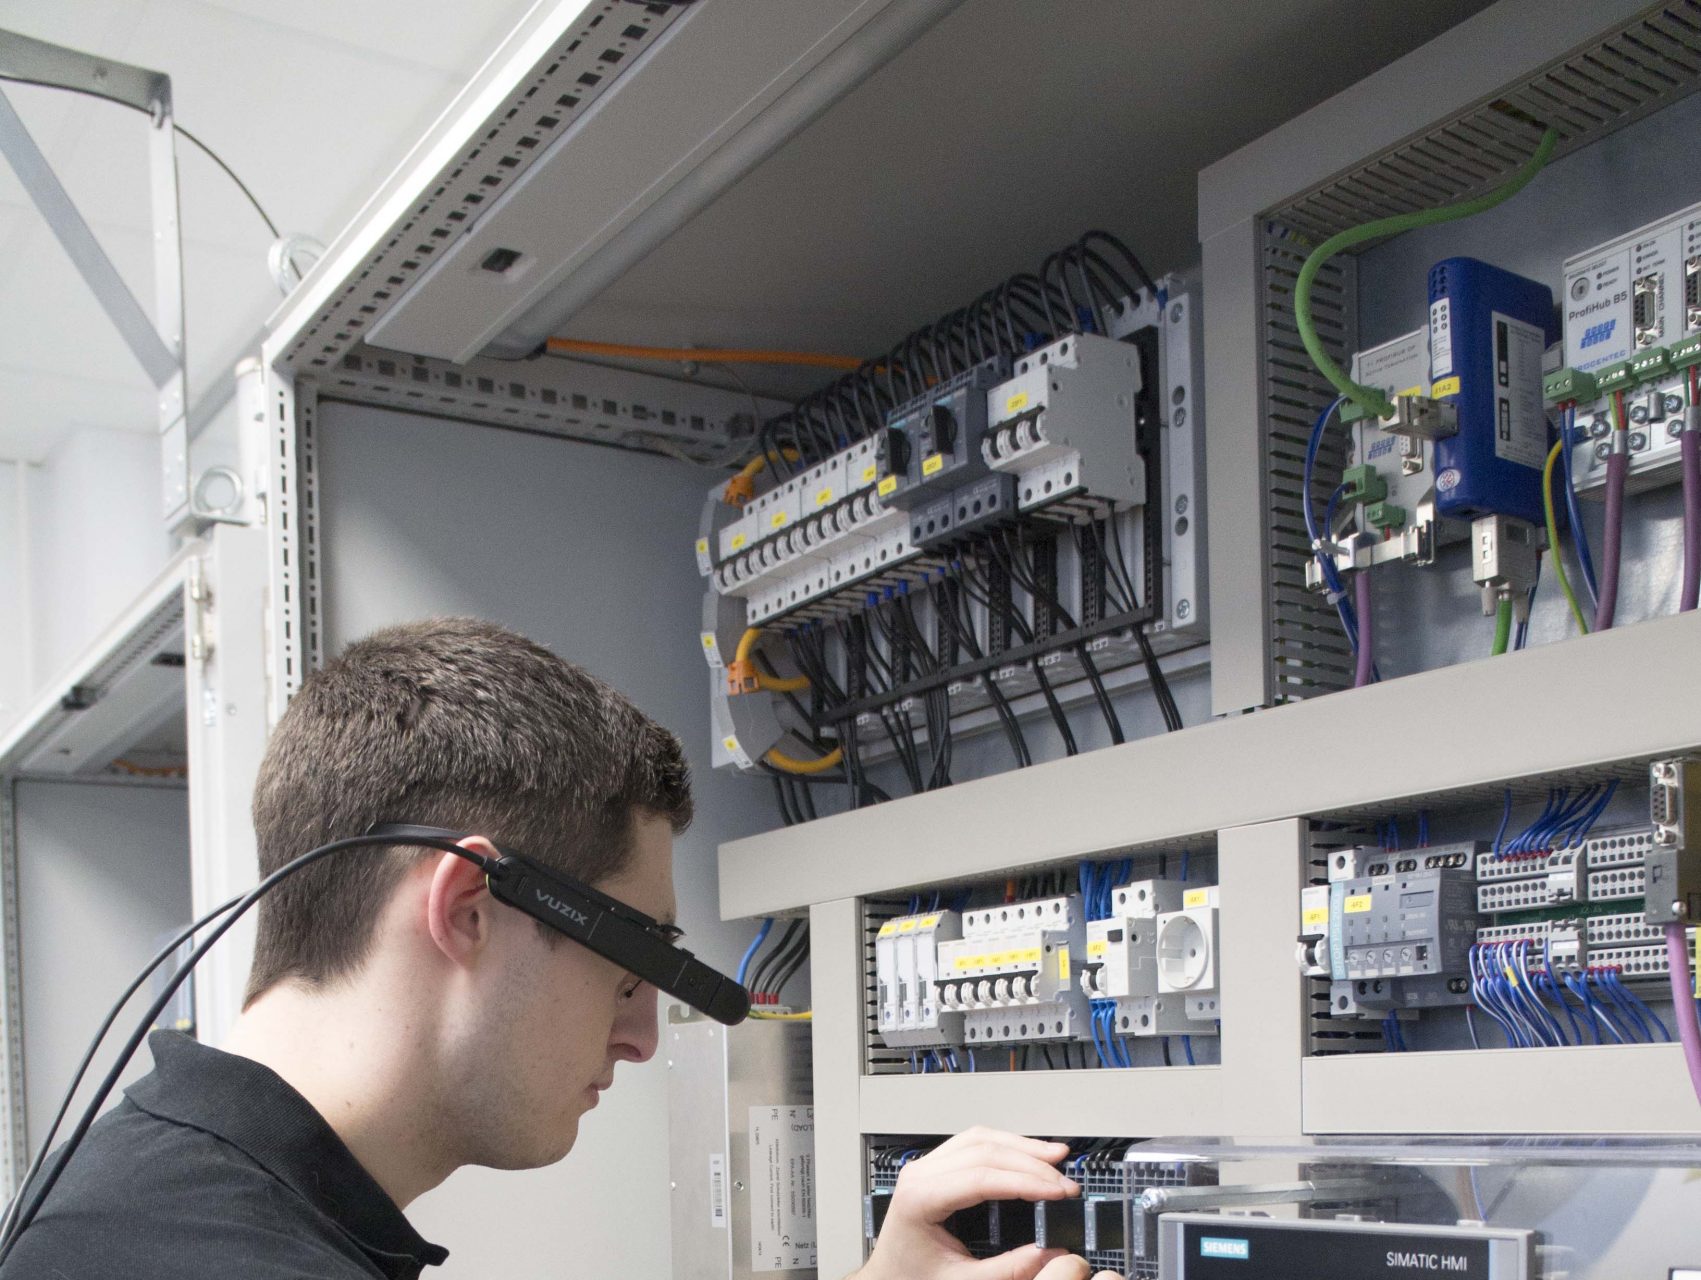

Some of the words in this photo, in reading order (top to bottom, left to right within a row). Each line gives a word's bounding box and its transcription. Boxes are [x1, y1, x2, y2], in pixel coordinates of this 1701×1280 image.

[1568, 299, 1611, 320] ProfiHub
[1613, 291, 1628, 305] B5
[1575, 350, 1626, 373] ROCENTEC
[536, 889, 588, 926] VUZIX
[1203, 1241, 1246, 1254] SIEMENS
[775, 1256, 782, 1268] PE
[793, 1257, 800, 1265] N
[1386, 1252, 1438, 1269] SIMATIC
[1441, 1257, 1467, 1271] HMI
